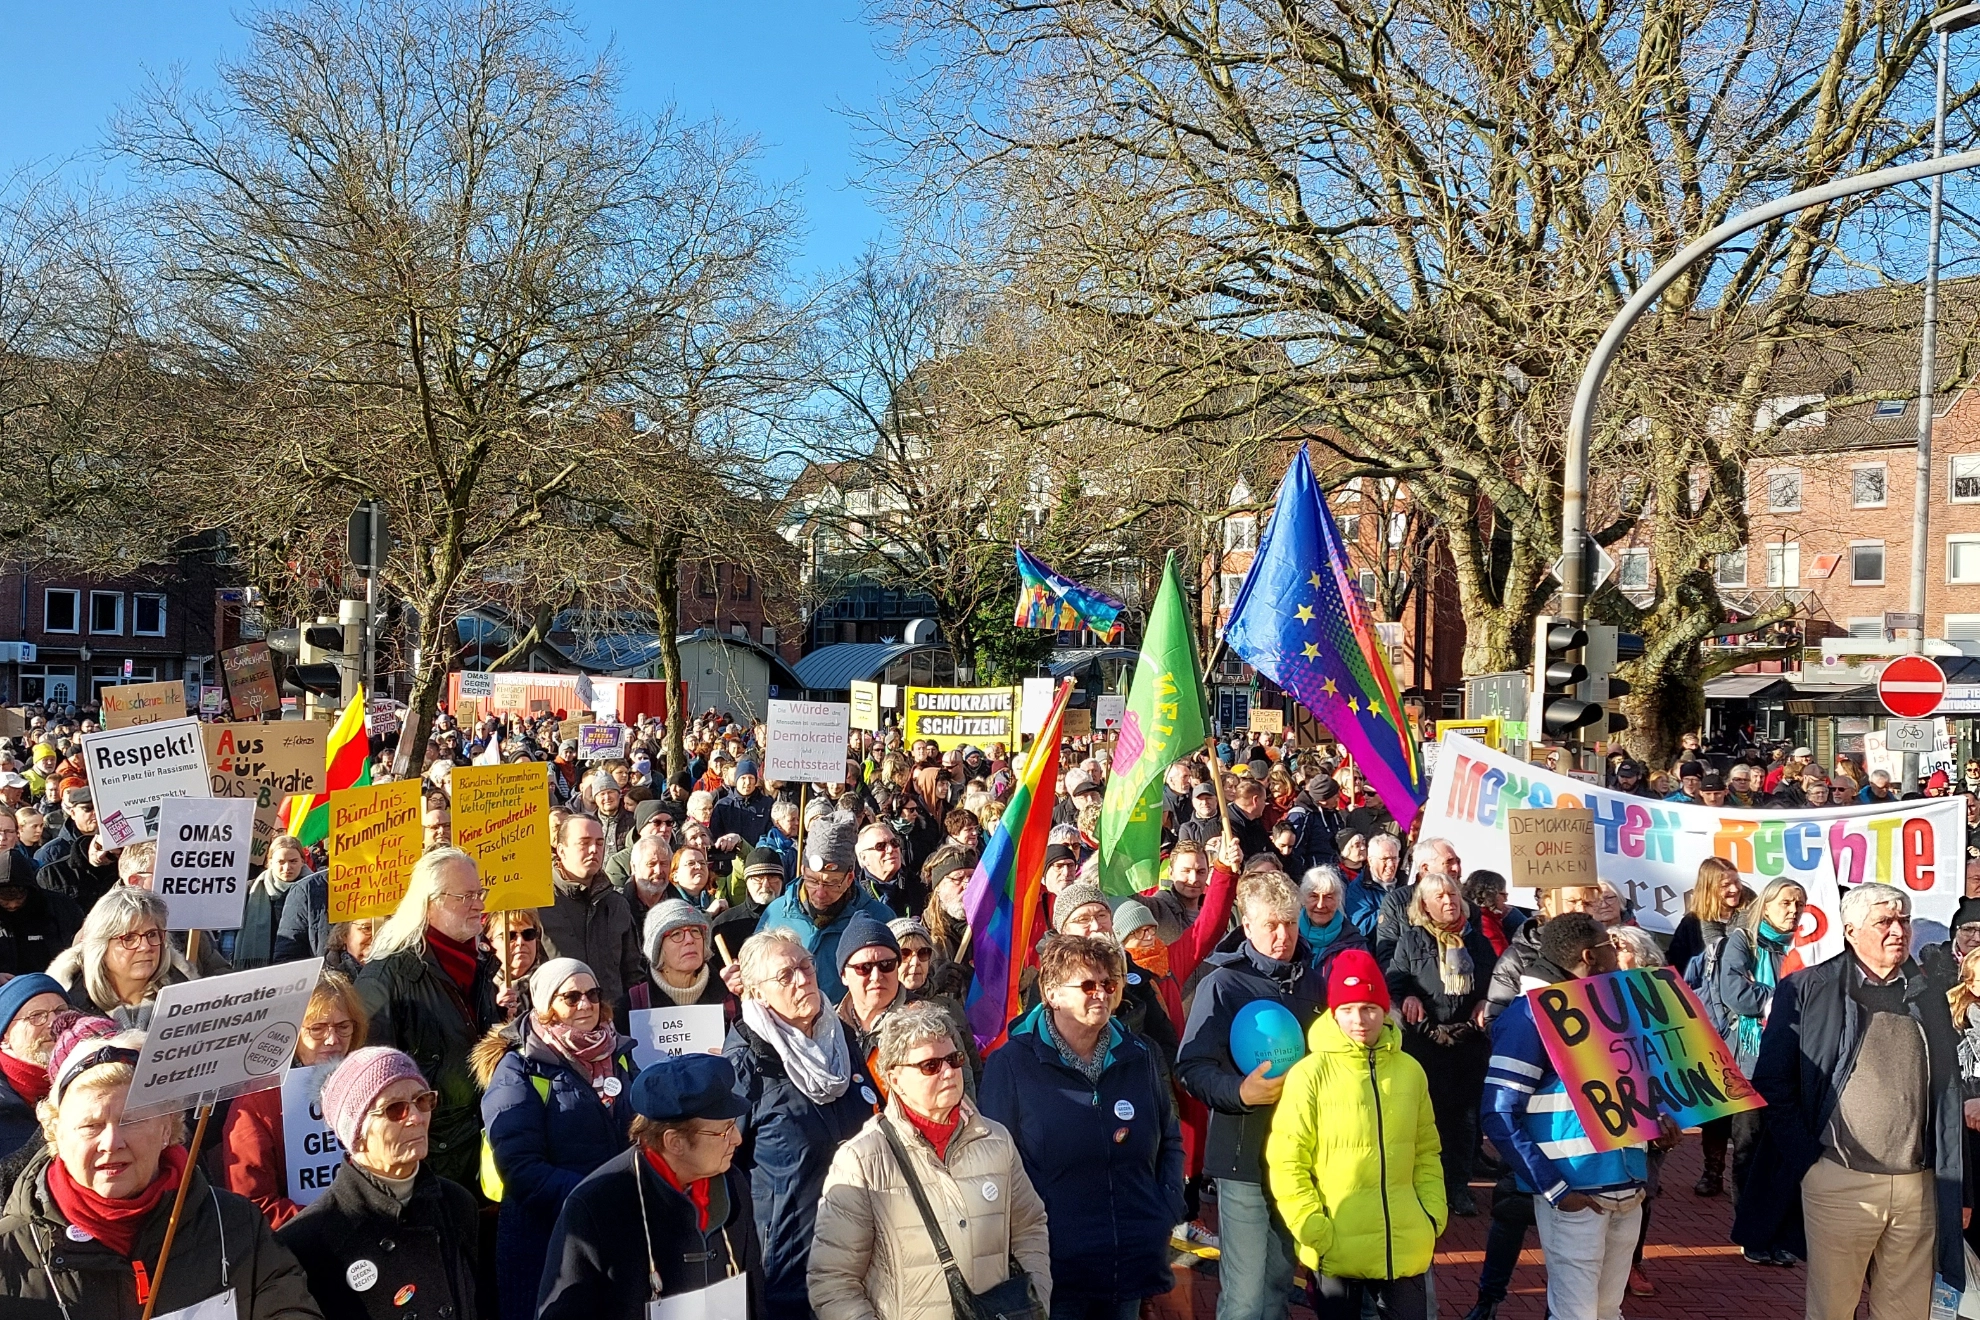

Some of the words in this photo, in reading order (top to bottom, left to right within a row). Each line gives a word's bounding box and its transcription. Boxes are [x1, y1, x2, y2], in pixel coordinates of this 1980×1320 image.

[464, 680, 491, 688] GEGEN
[467, 672, 489, 680] OMAS
[462, 687, 492, 696] RECHTS
[789, 702, 830, 715] Würde
[917, 693, 1012, 712] DEMOKRATIE
[922, 715, 1005, 735] SCHÜTZEN!
[216, 729, 264, 756] Aus
[773, 730, 843, 744] Demokratie
[1902, 740, 1918, 749] frei
[96, 732, 196, 770] Respekt!
[216, 756, 267, 777] für
[771, 757, 842, 772] Rechtsstaat
[101, 776, 121, 786] Kein
[122, 771, 143, 782] Platz
[144, 768, 156, 779] für
[157, 762, 198, 776] Rassismus
[210, 774, 246, 798] DAS
[473, 784, 526, 802] Demokratie
[529, 782, 545, 793] und
[336, 789, 407, 829] Bündnis:
[334, 807, 417, 857] Krummhörn
[459, 825, 483, 847] Keine
[485, 802, 539, 834] Grundrechte
[1508, 816, 1595, 835] DEMOKRATIE
[179, 825, 233, 843] OMAS
[475, 823, 536, 860] Faschisten
[379, 834, 405, 855] für
[1534, 840, 1573, 857] OHNE
[170, 851, 235, 868] GEGEN
[501, 849, 517, 863] wie
[332, 849, 416, 882] Demokratie
[1527, 859, 1588, 876] HAKEN
[161, 876, 237, 895] RECHTS
[333, 876, 362, 893] und
[166, 986, 277, 1019] Demokratie
[1537, 968, 1698, 1048] BUNT
[159, 1007, 269, 1041] GEMEINSAM
[662, 1019, 684, 1030] DAS
[267, 1030, 291, 1044] OMAS
[658, 1033, 692, 1044] BESTE
[257, 1041, 285, 1057] GEGEN
[667, 1047, 683, 1057] AM
[1253, 1048, 1274, 1058] Kein
[1274, 1047, 1293, 1057] Platz
[1608, 1026, 1688, 1075] STATT
[248, 1052, 279, 1069] RECHTS
[143, 1060, 219, 1088] Jetzt!!!!
[1580, 1061, 1729, 1138] BRAUN
[350, 1261, 368, 1274] OMAS
[352, 1267, 372, 1282] GEGEN
[354, 1273, 377, 1289] RECHTS
